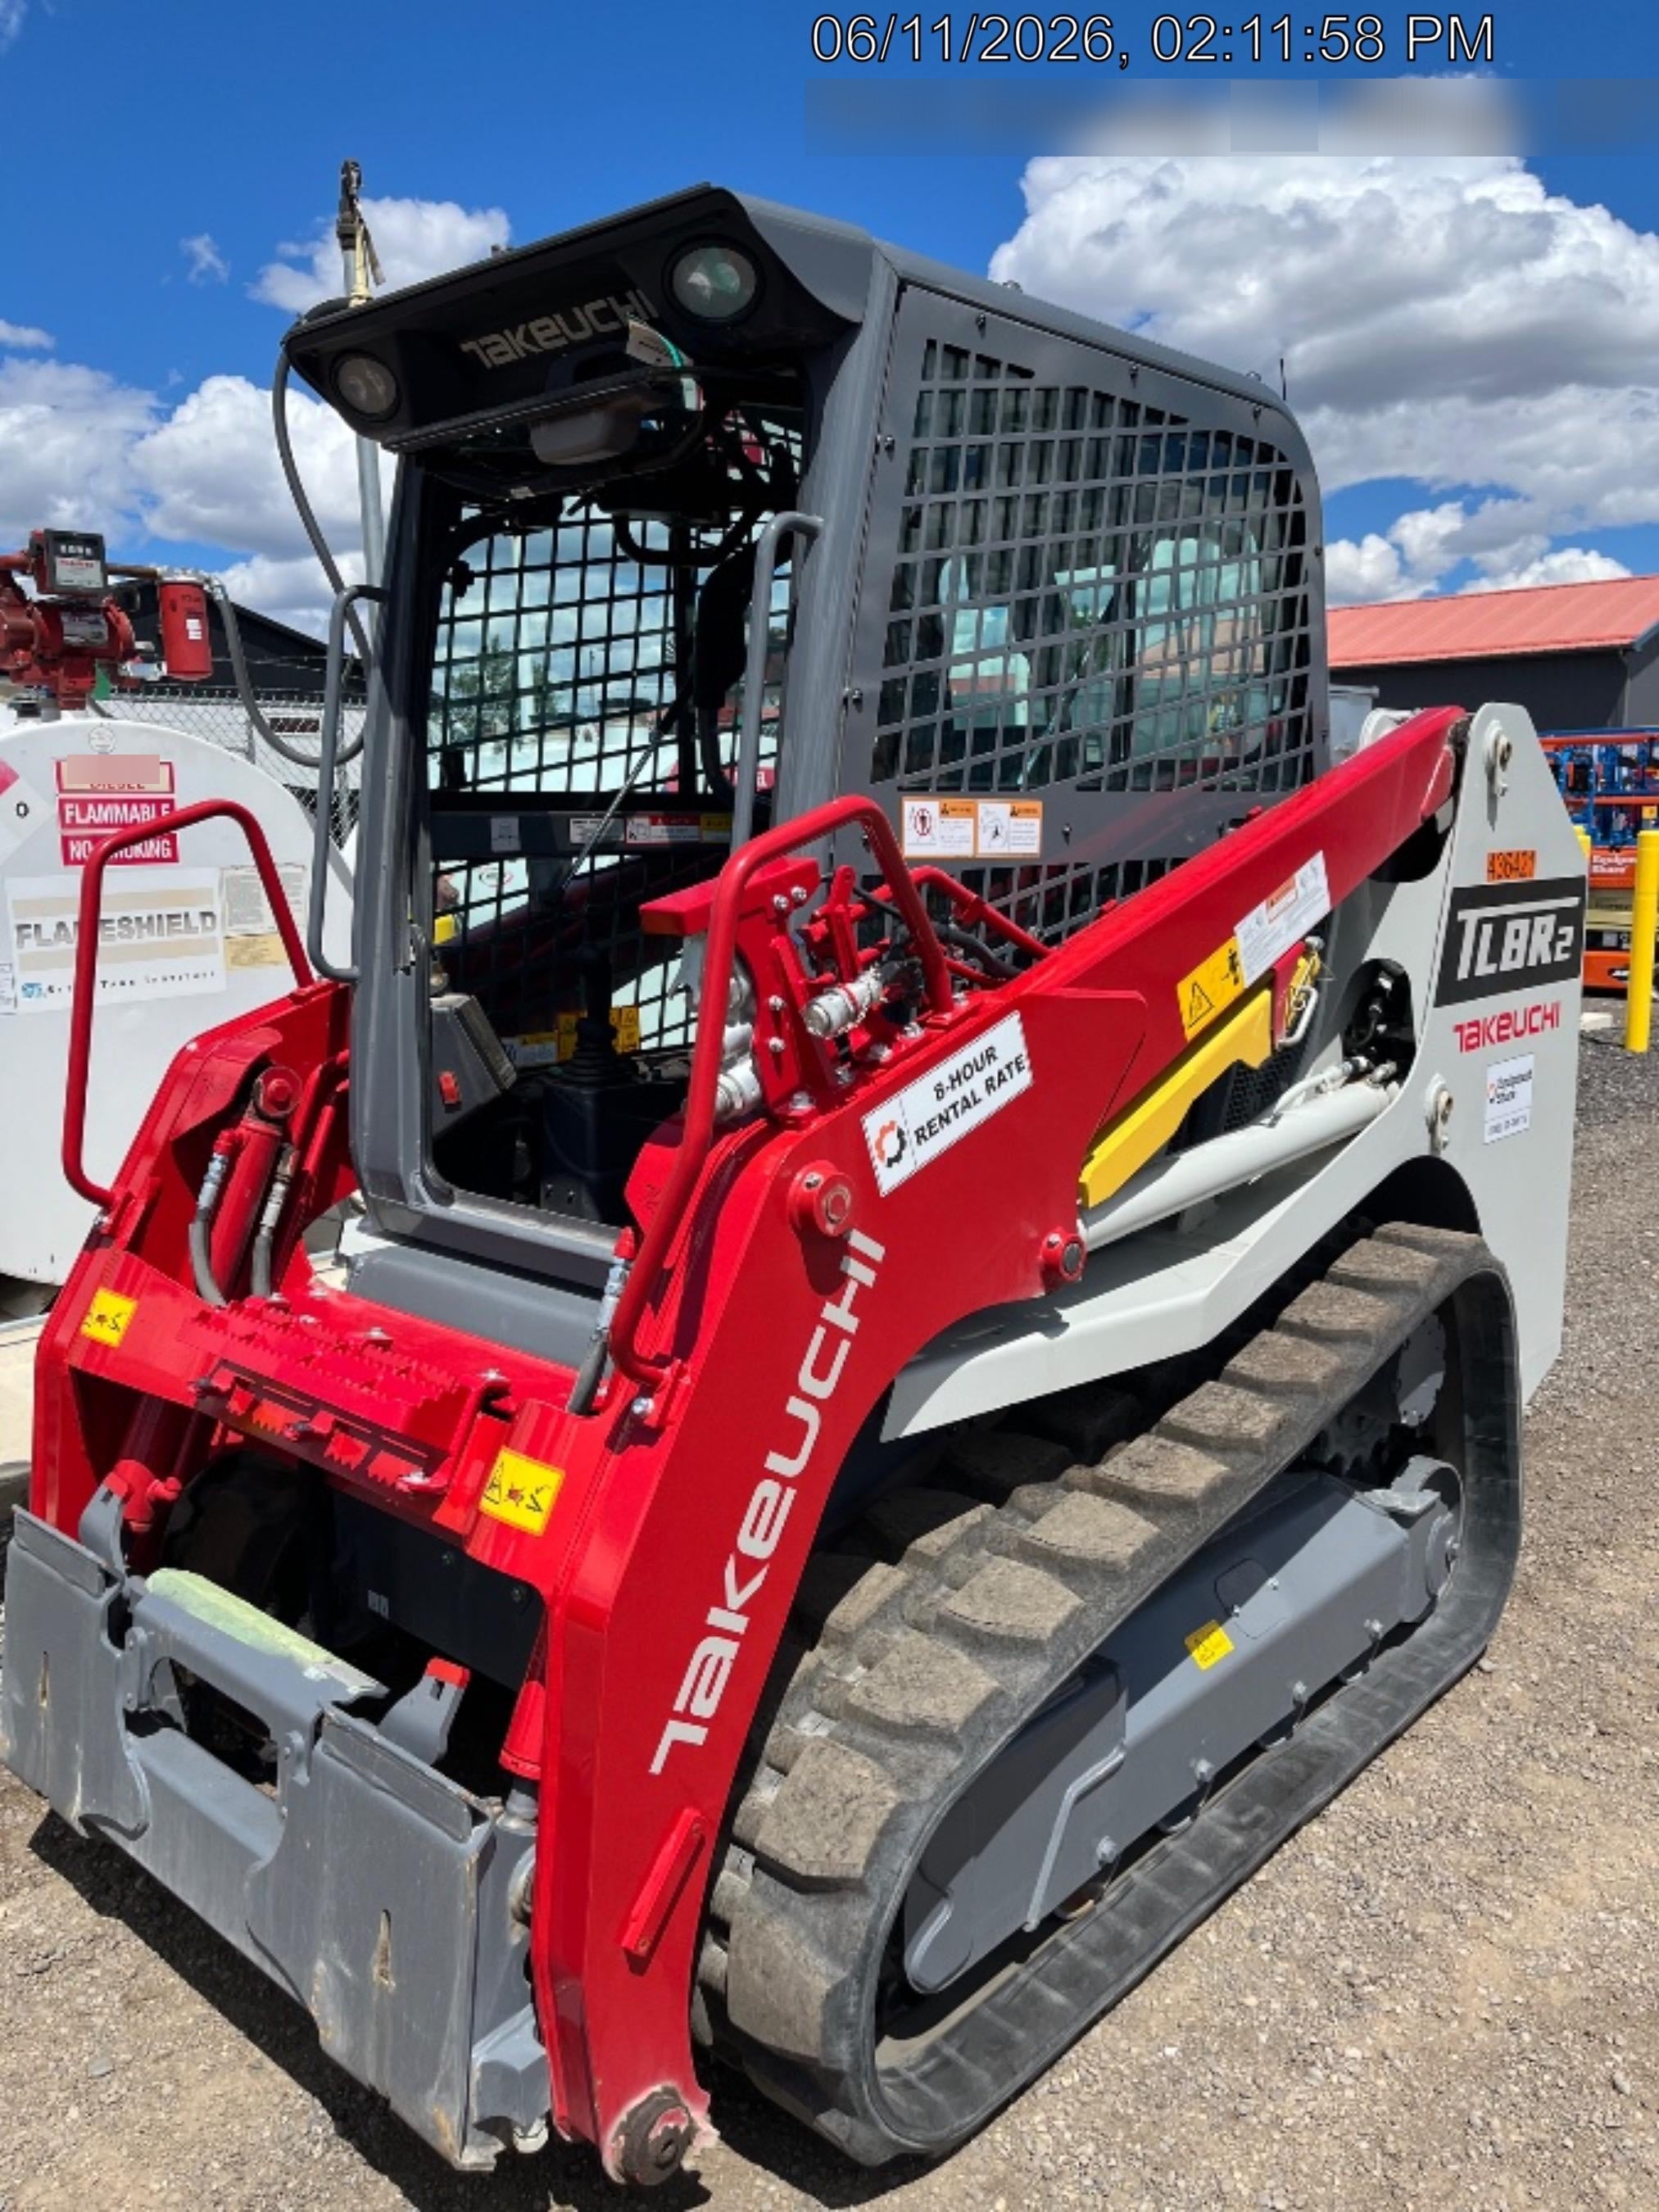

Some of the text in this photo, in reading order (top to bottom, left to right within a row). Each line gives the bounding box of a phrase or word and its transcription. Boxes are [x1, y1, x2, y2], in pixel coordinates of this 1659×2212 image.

[16, 911, 216, 949] FLAESHIELD
[1457, 897, 1580, 981] TL8R2
[1453, 1000, 1560, 1053] TAKEUCHI
[913, 1054, 1026, 1145] RENTAL RATE
[933, 1045, 999, 1101] 8-HOUR
[649, 1229, 886, 1775] TAKEUCHI
